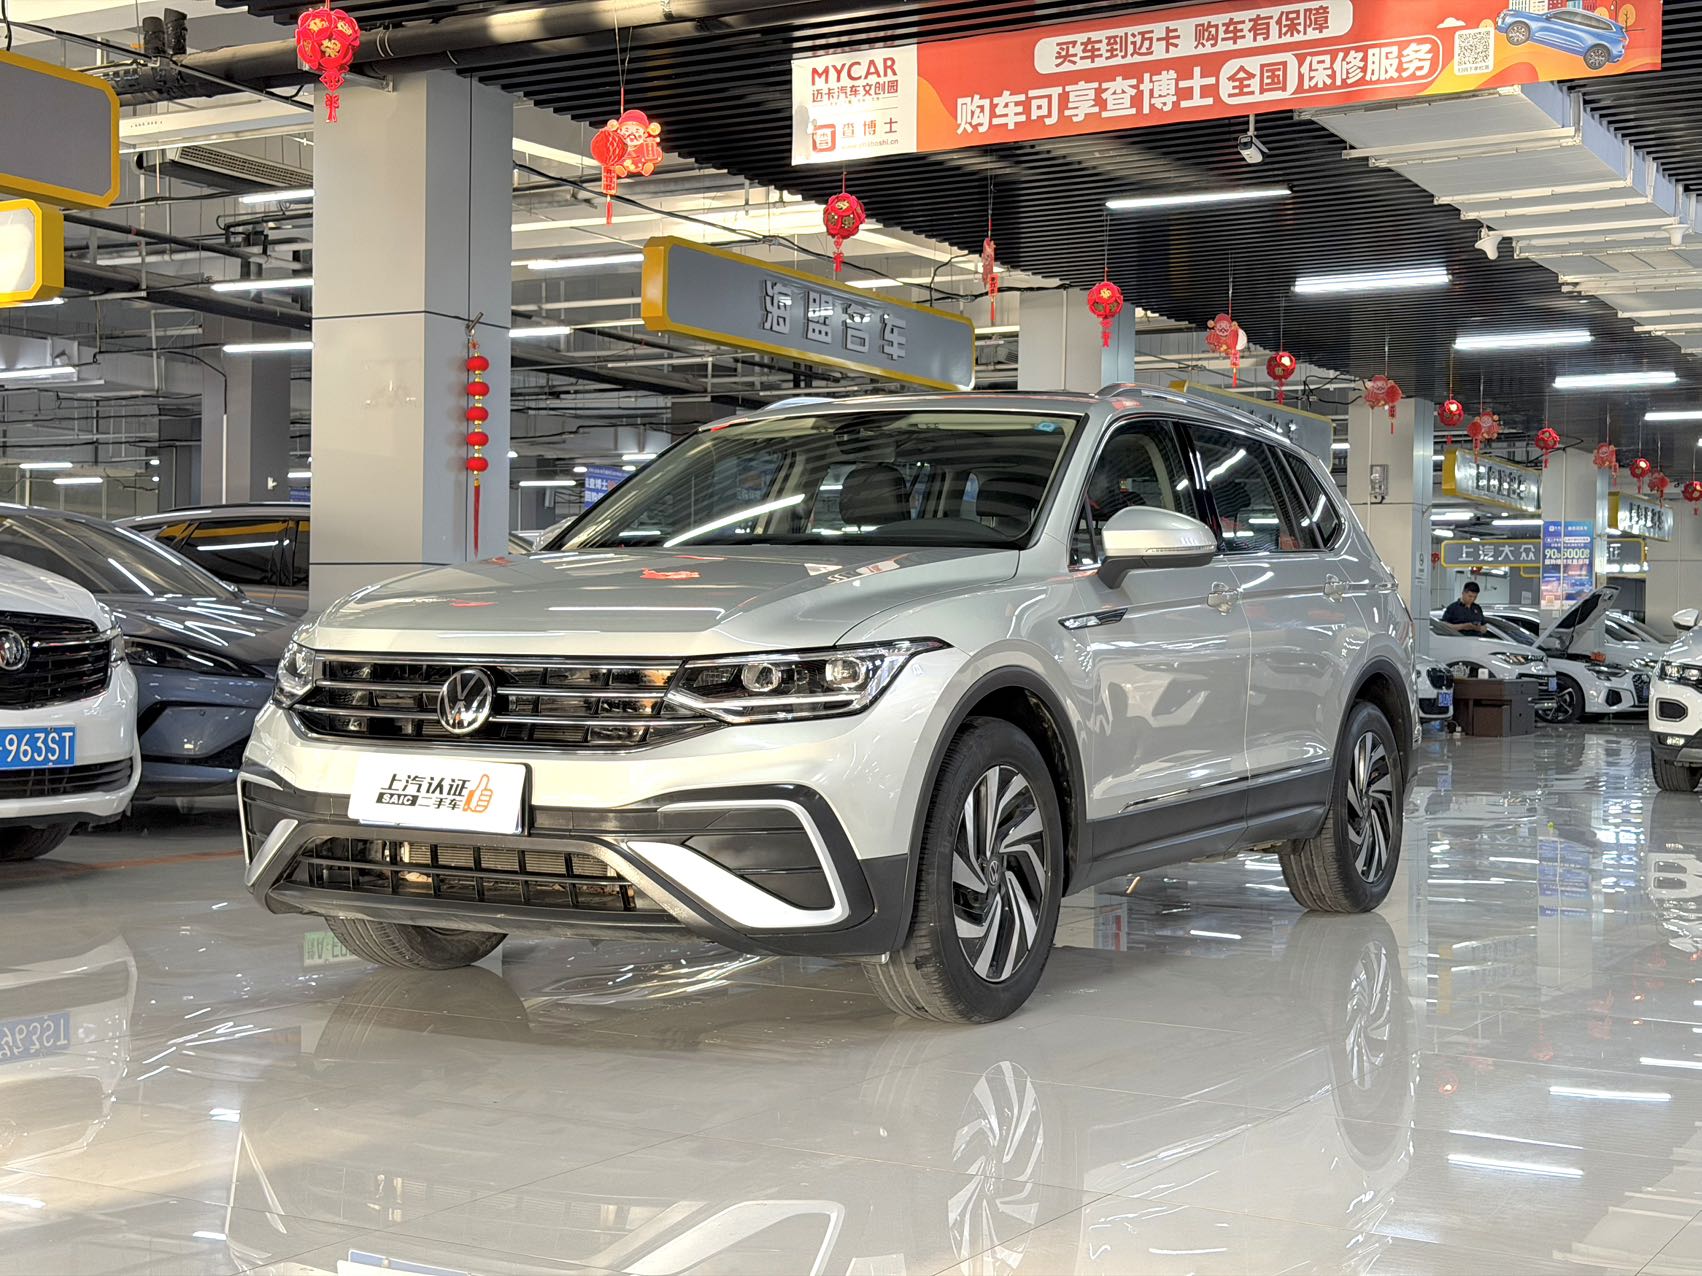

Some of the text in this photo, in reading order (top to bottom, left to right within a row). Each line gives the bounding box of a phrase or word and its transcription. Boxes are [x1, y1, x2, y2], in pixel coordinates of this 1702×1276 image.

[1054, 6, 1330, 67] 买车到迈卡 购车有保障
[811, 57, 898, 86] MYCAR
[812, 80, 899, 103] 迈卡汽车文创园
[1458, 545, 1536, 561] 上汽大众
[380, 773, 471, 797] 上汽认证
[382, 793, 414, 805] SAIC
[418, 796, 463, 811] 二手车
